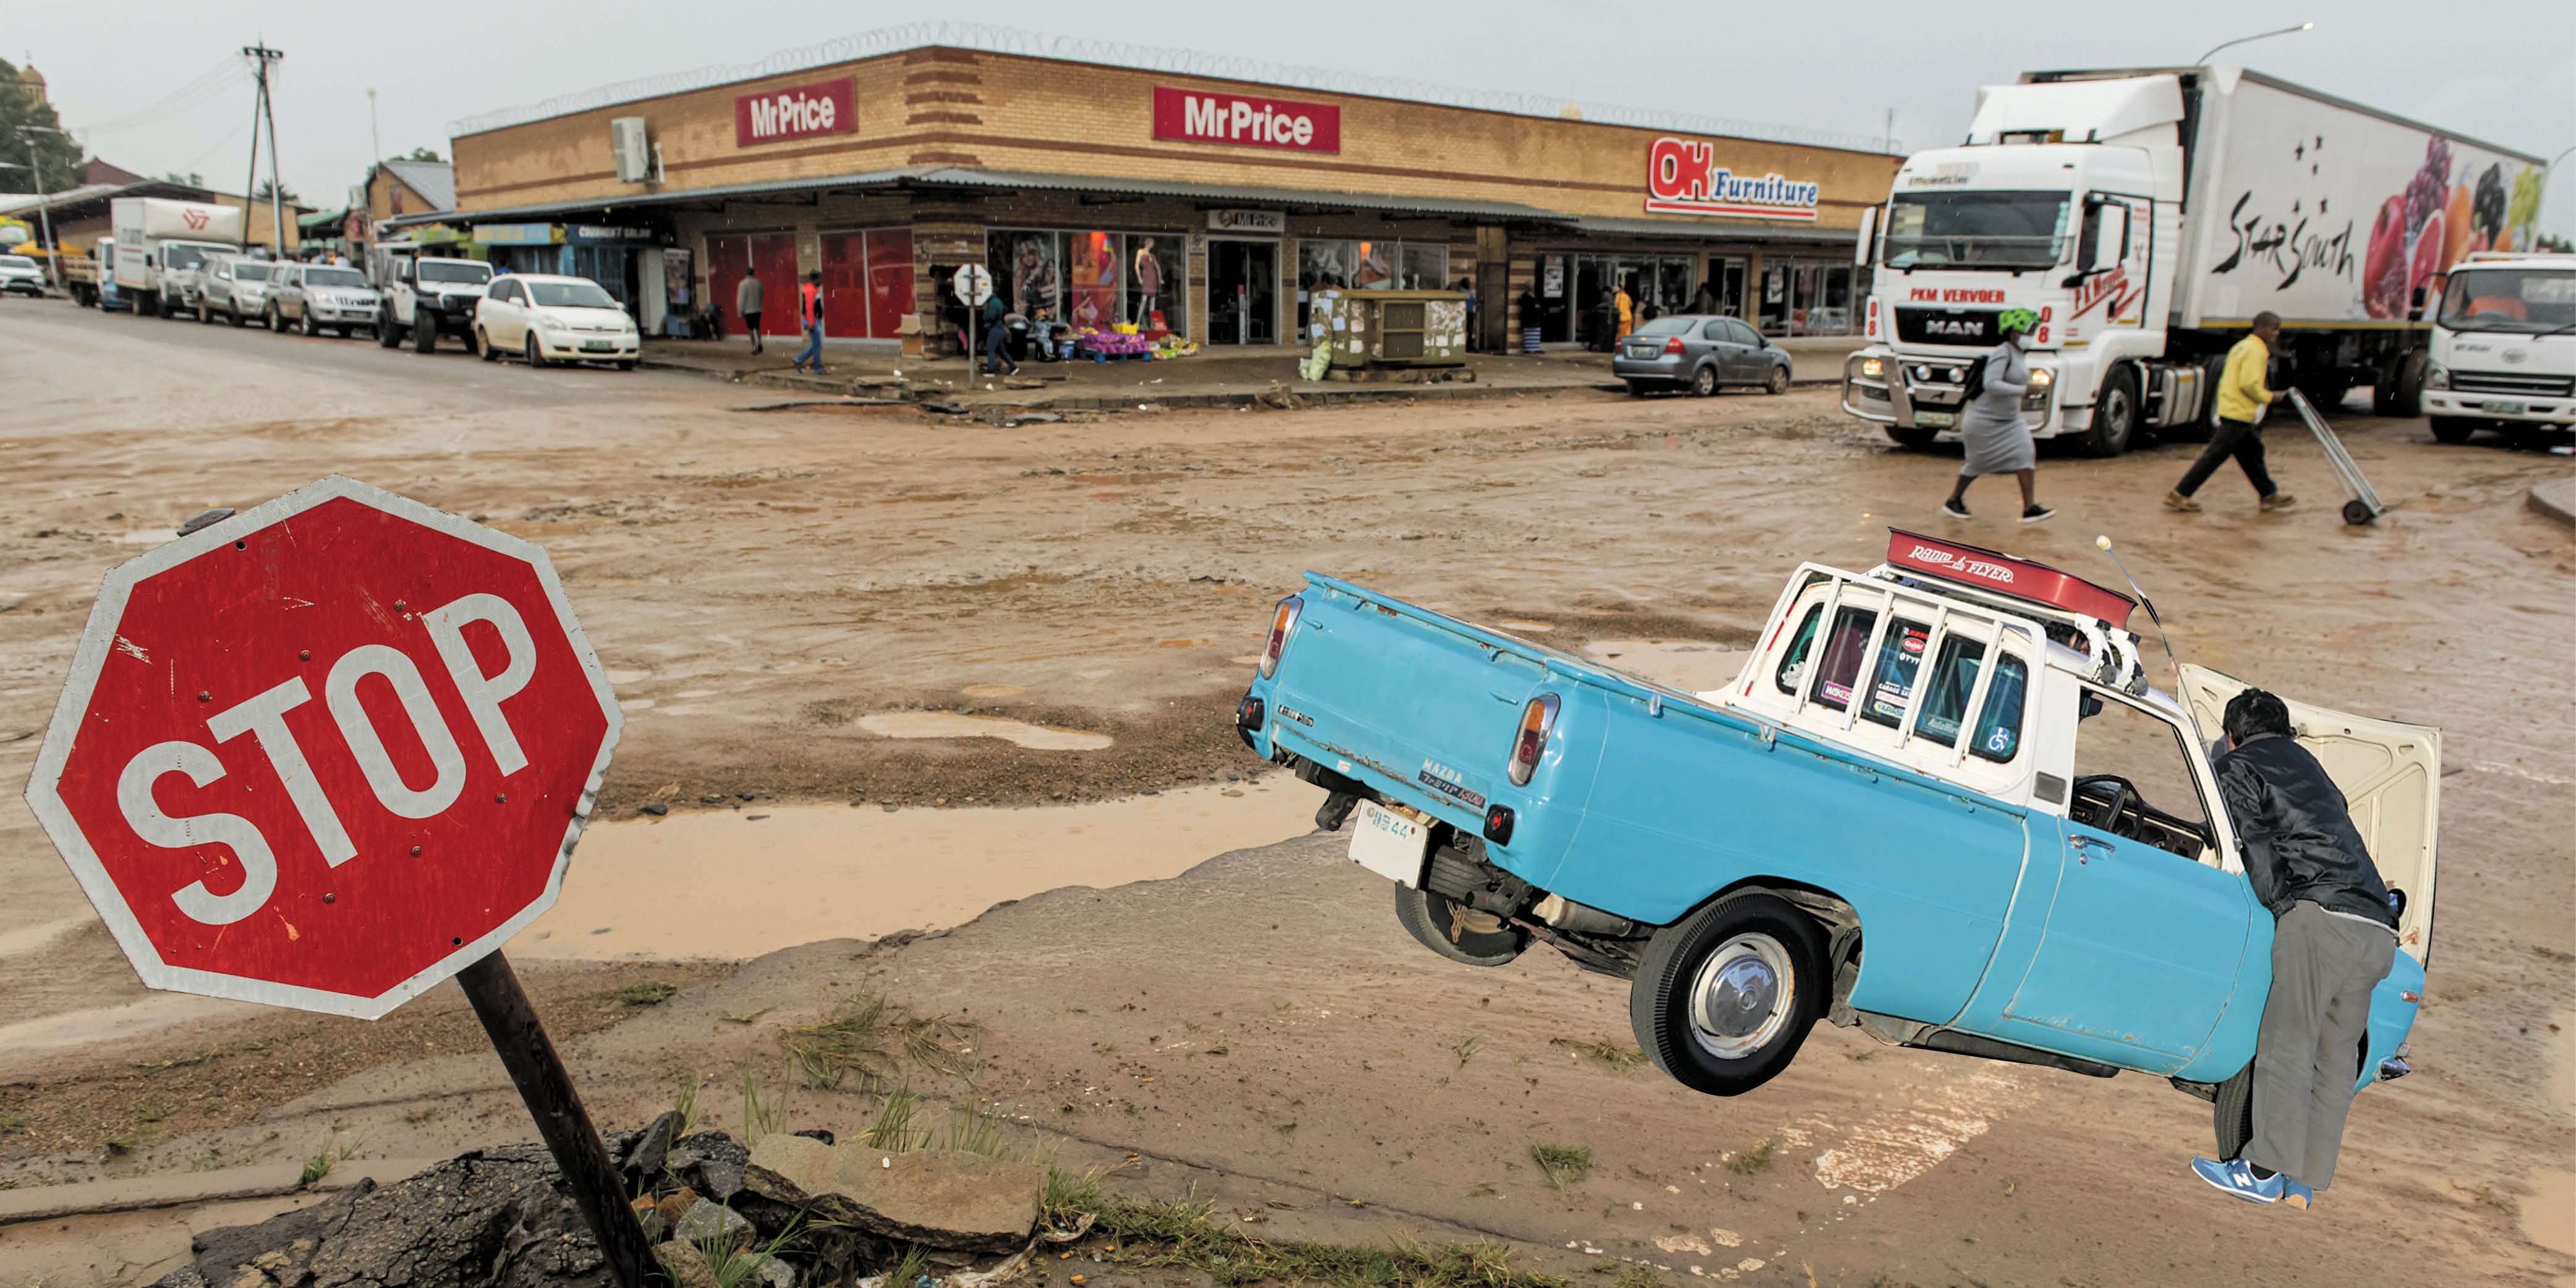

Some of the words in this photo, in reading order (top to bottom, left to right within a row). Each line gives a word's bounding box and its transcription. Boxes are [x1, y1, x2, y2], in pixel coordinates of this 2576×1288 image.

[1650, 137, 1713, 200] OK
[1714, 169, 1818, 205] Furniture
[1910, 288, 1937, 302] PKM
[1943, 288, 2005, 303] VERVOER
[1926, 320, 1983, 336] MAN
[1908, 545, 1953, 562] RADIO
[1966, 561, 2013, 583] FLYER
[117, 592, 537, 925] STOP
[1422, 757, 1463, 784] MAZDA
[2233, 1173, 2253, 1187] N
